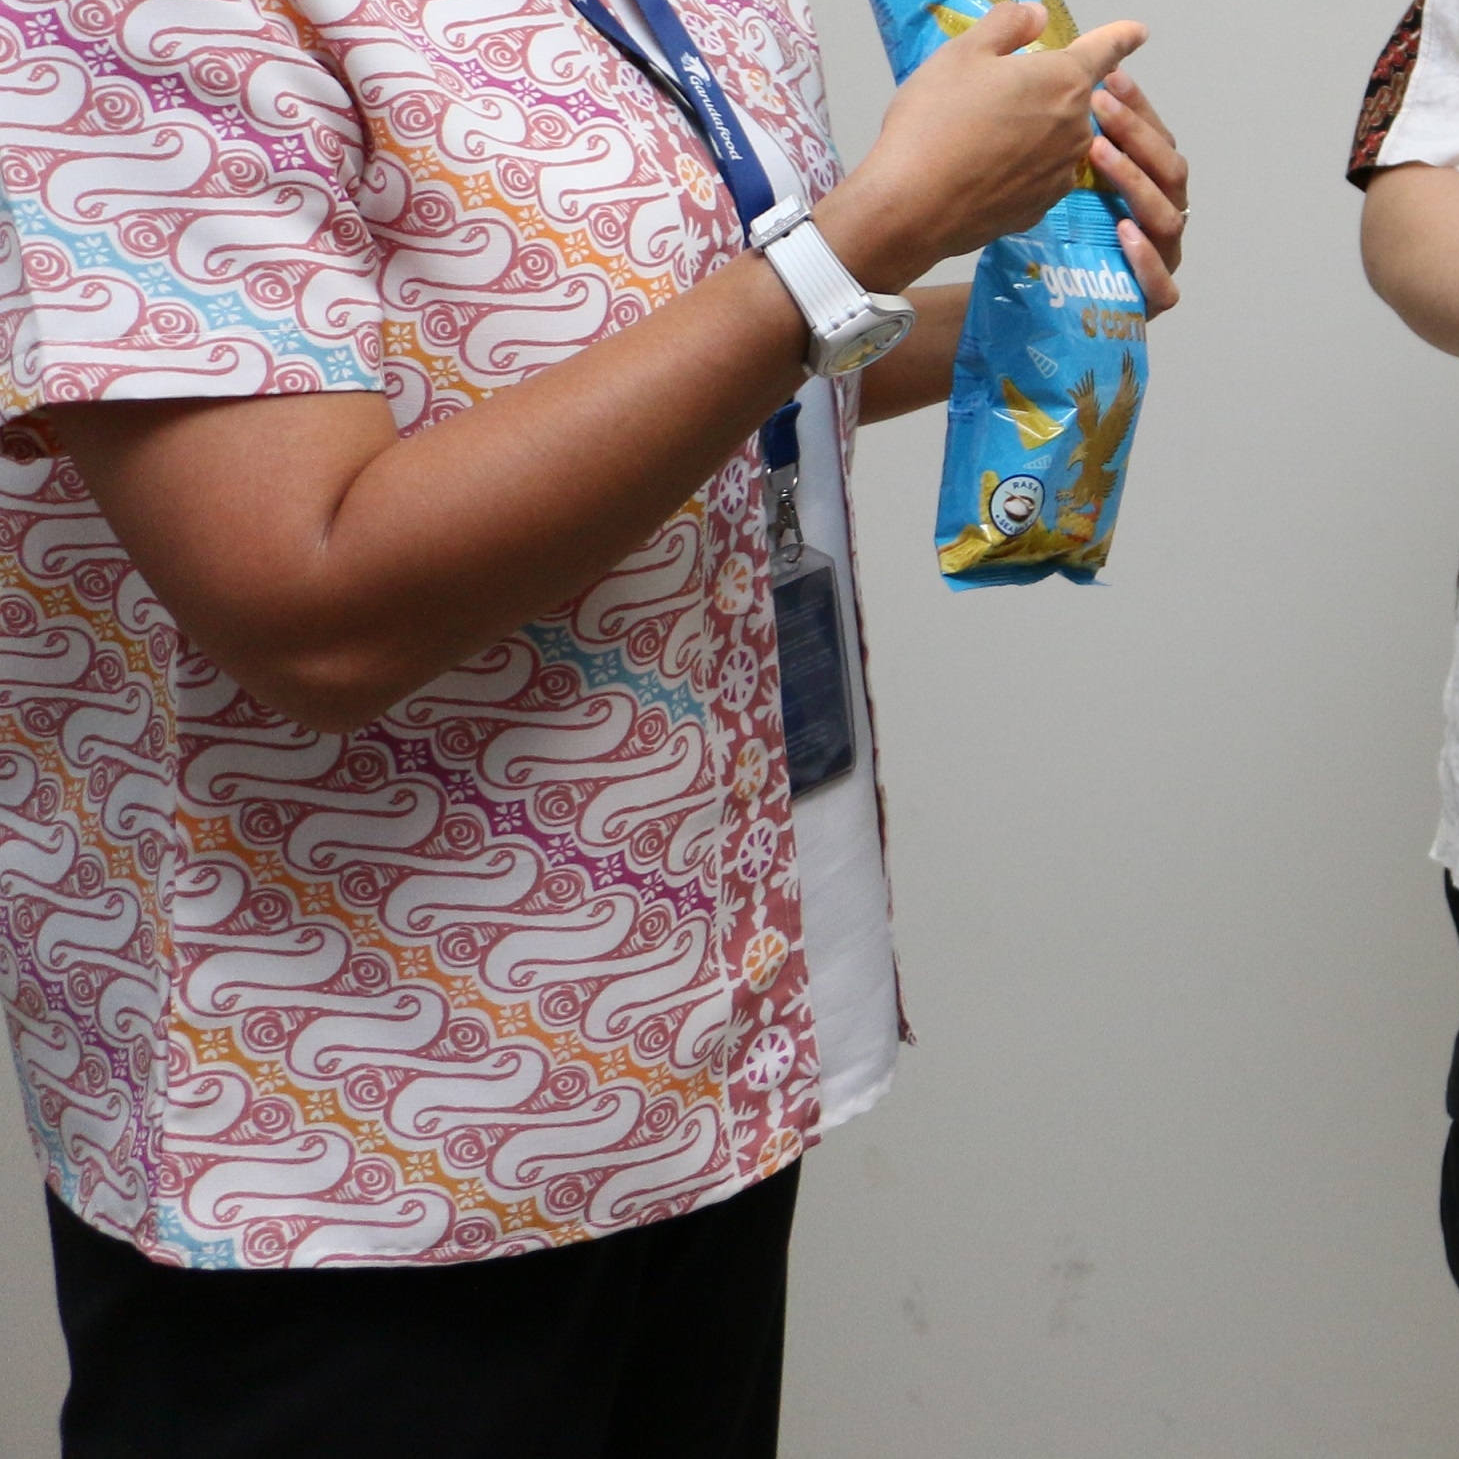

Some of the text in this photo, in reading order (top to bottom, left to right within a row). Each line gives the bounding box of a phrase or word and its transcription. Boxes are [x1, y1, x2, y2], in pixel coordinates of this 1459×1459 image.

[688, 72, 744, 162] Garudafood
[1040, 259, 1139, 309] garuda
[1081, 301, 1147, 342] o'corn
[1012, 480, 1040, 494] RASA
[998, 518, 1014, 533] SEA
